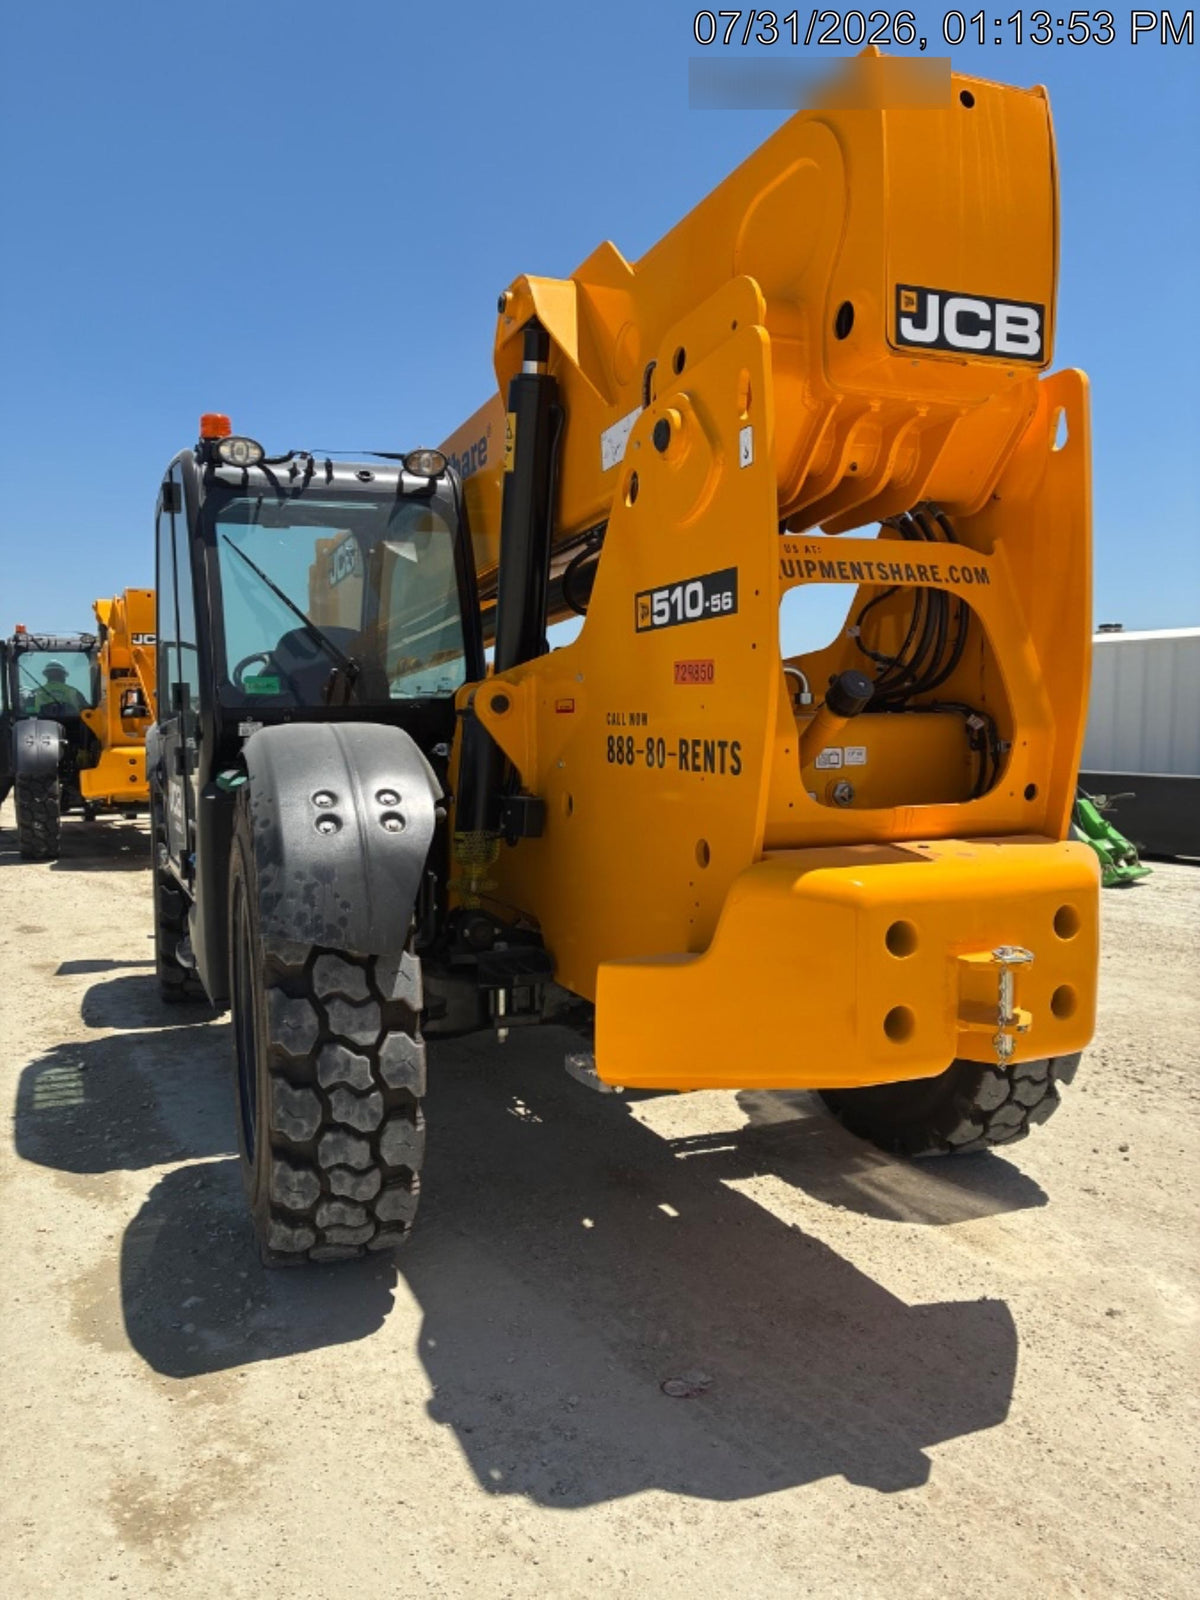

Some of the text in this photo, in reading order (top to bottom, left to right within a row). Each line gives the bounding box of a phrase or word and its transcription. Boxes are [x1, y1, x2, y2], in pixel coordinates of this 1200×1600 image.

[901, 294, 1041, 355] JCB
[779, 559, 990, 585] UIPMENTSHARE.COM
[132, 633, 157, 645] JC
[606, 712, 648, 726] CALL NOW
[607, 735, 742, 776] 888-80-RENTS
